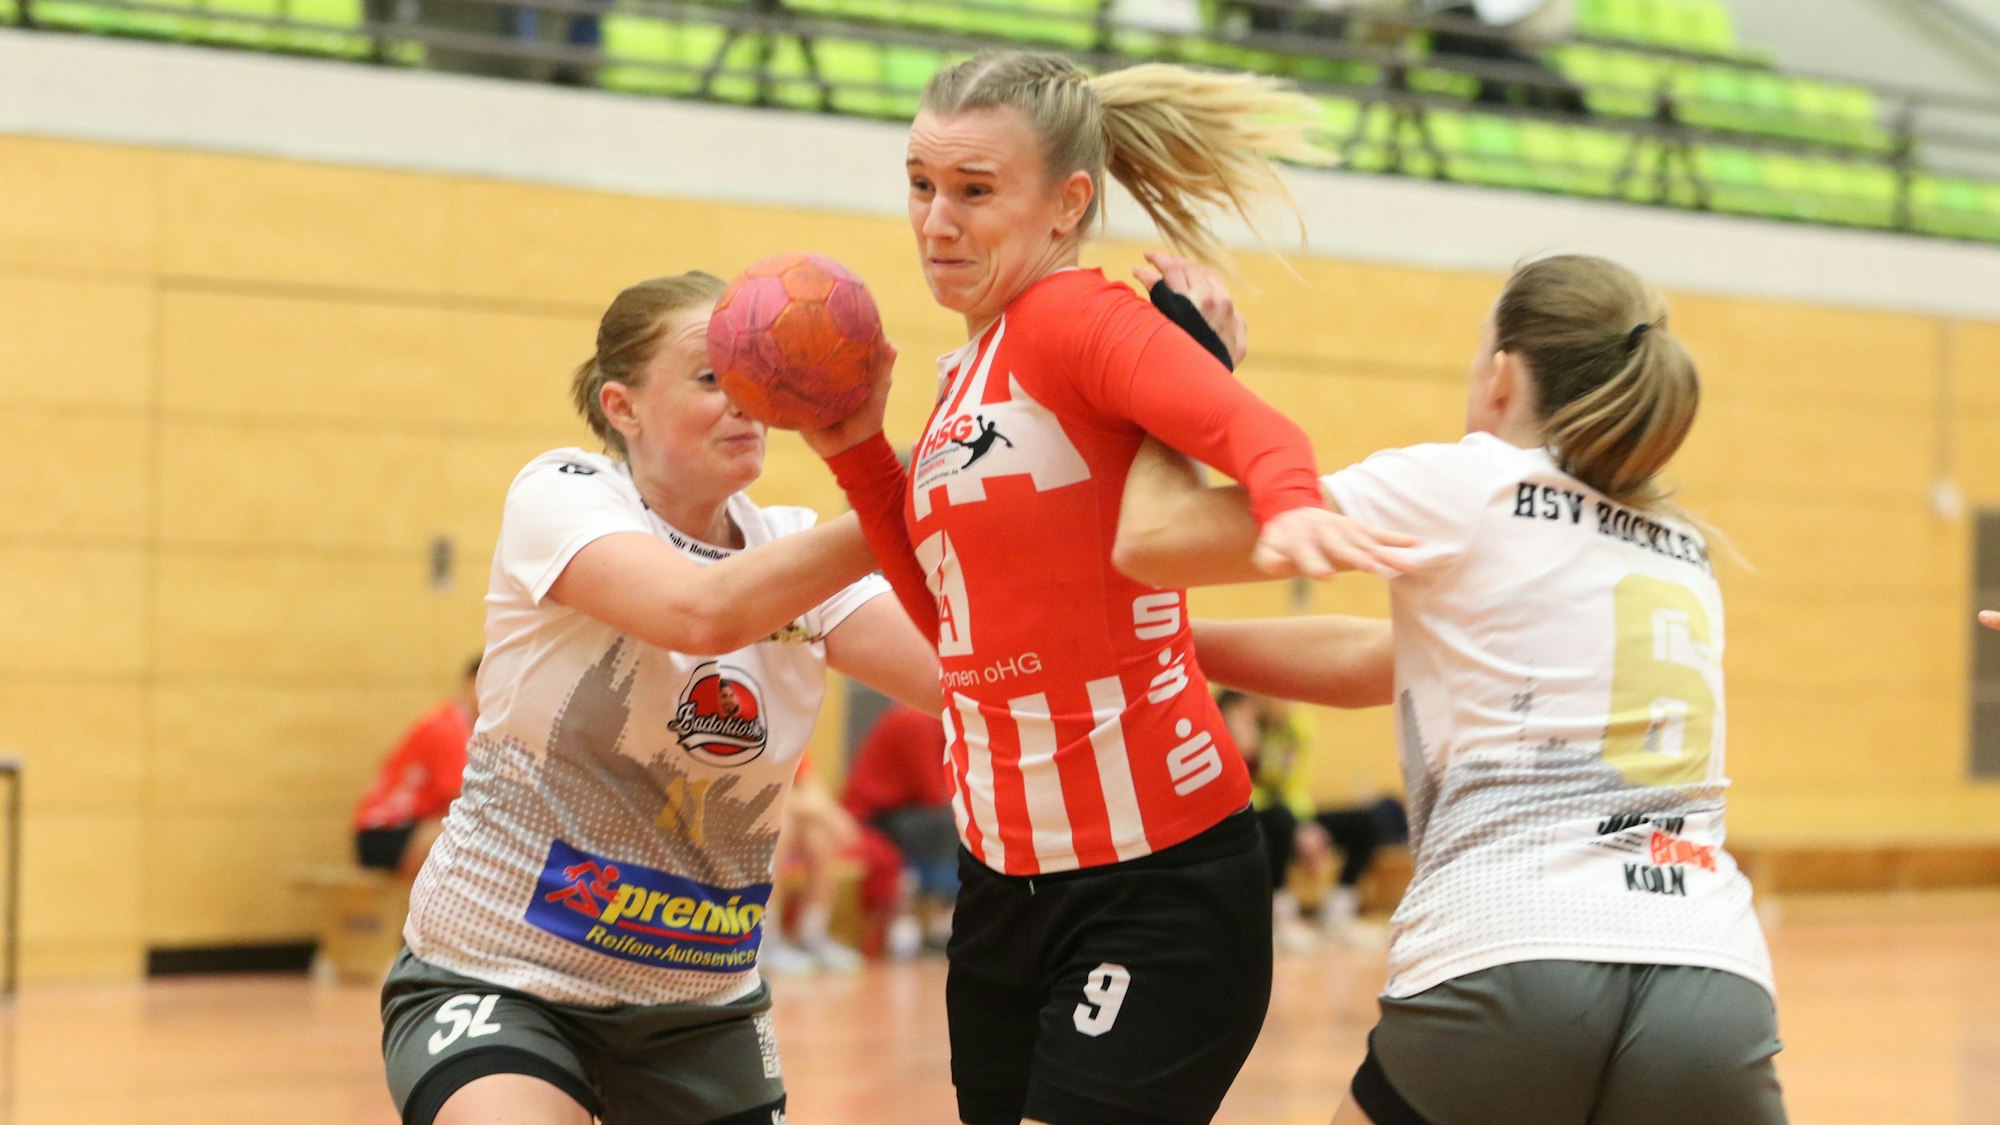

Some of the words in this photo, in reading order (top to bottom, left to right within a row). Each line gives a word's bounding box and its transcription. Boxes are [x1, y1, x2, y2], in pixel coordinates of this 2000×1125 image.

[922, 414, 973, 459] HSG
[1513, 481, 1586, 524] HSV
[984, 652, 1042, 683] oHG
[1603, 572, 1717, 787] 6
[599, 882, 767, 936] premio
[427, 993, 501, 1056] SL
[1072, 962, 1131, 1037] 9
